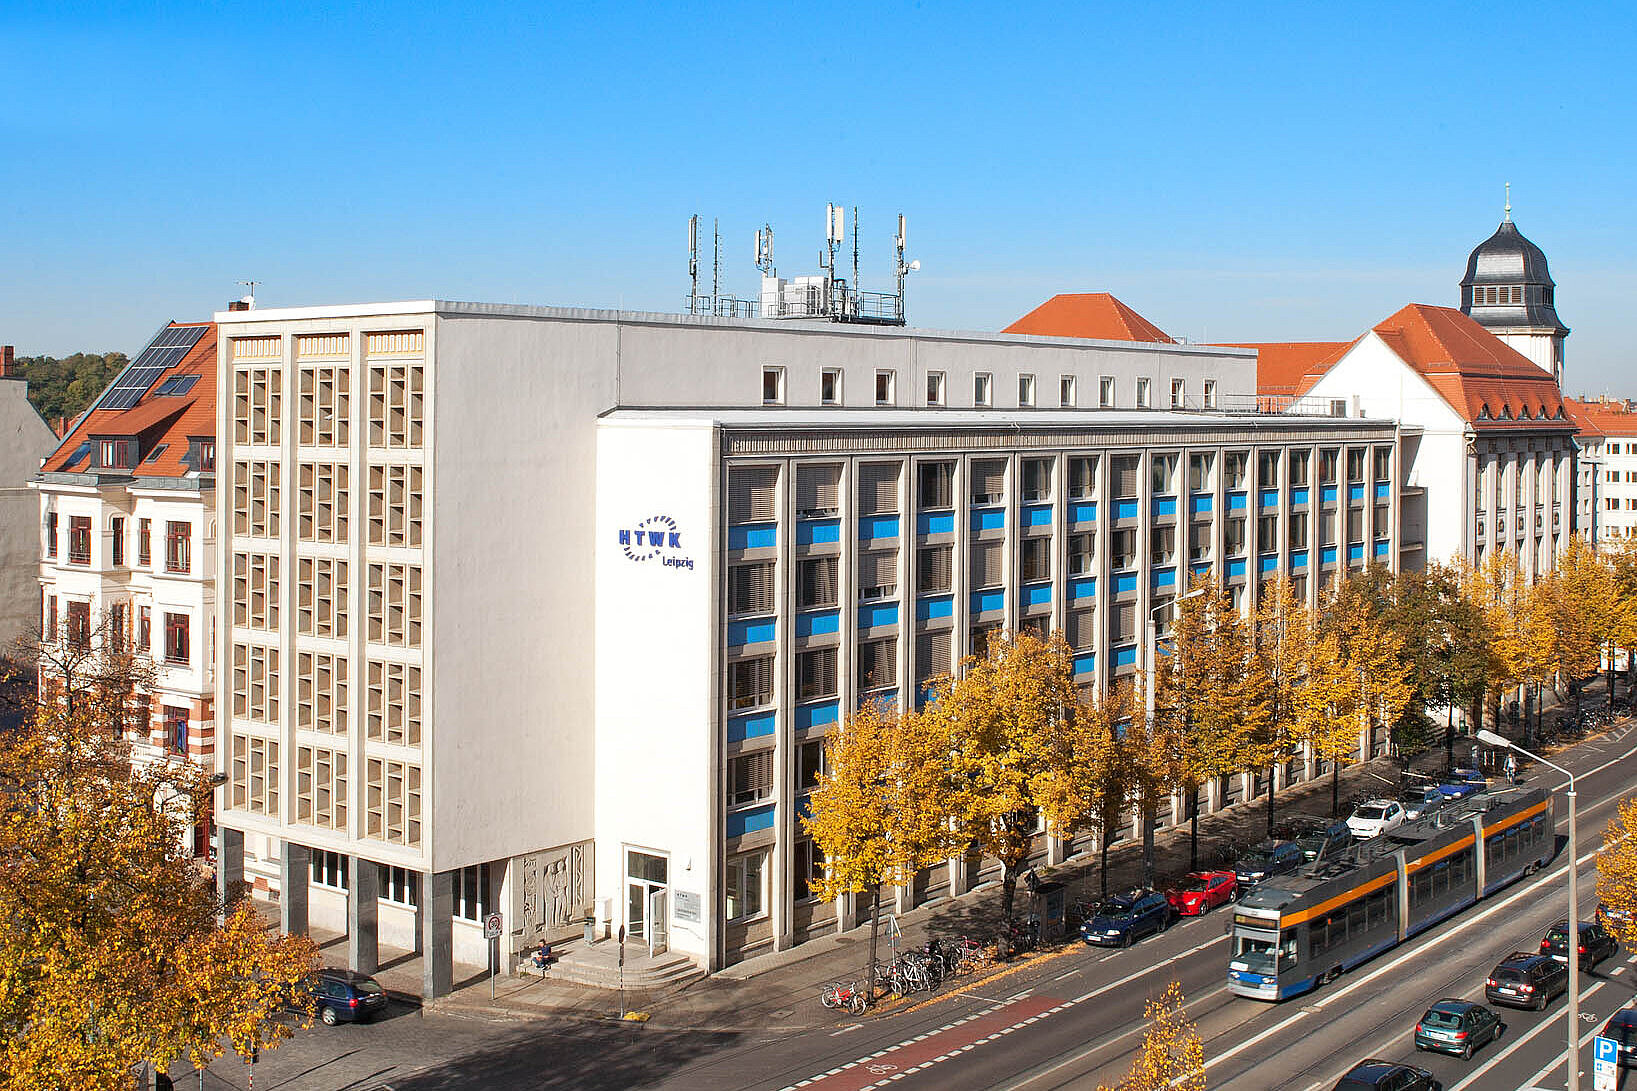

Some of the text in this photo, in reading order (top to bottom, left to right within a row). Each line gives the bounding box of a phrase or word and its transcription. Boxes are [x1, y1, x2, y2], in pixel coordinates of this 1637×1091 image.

[619, 529, 681, 548] HTWK
[662, 555, 694, 570] Leipzig
[1600, 1041, 1613, 1059] P
